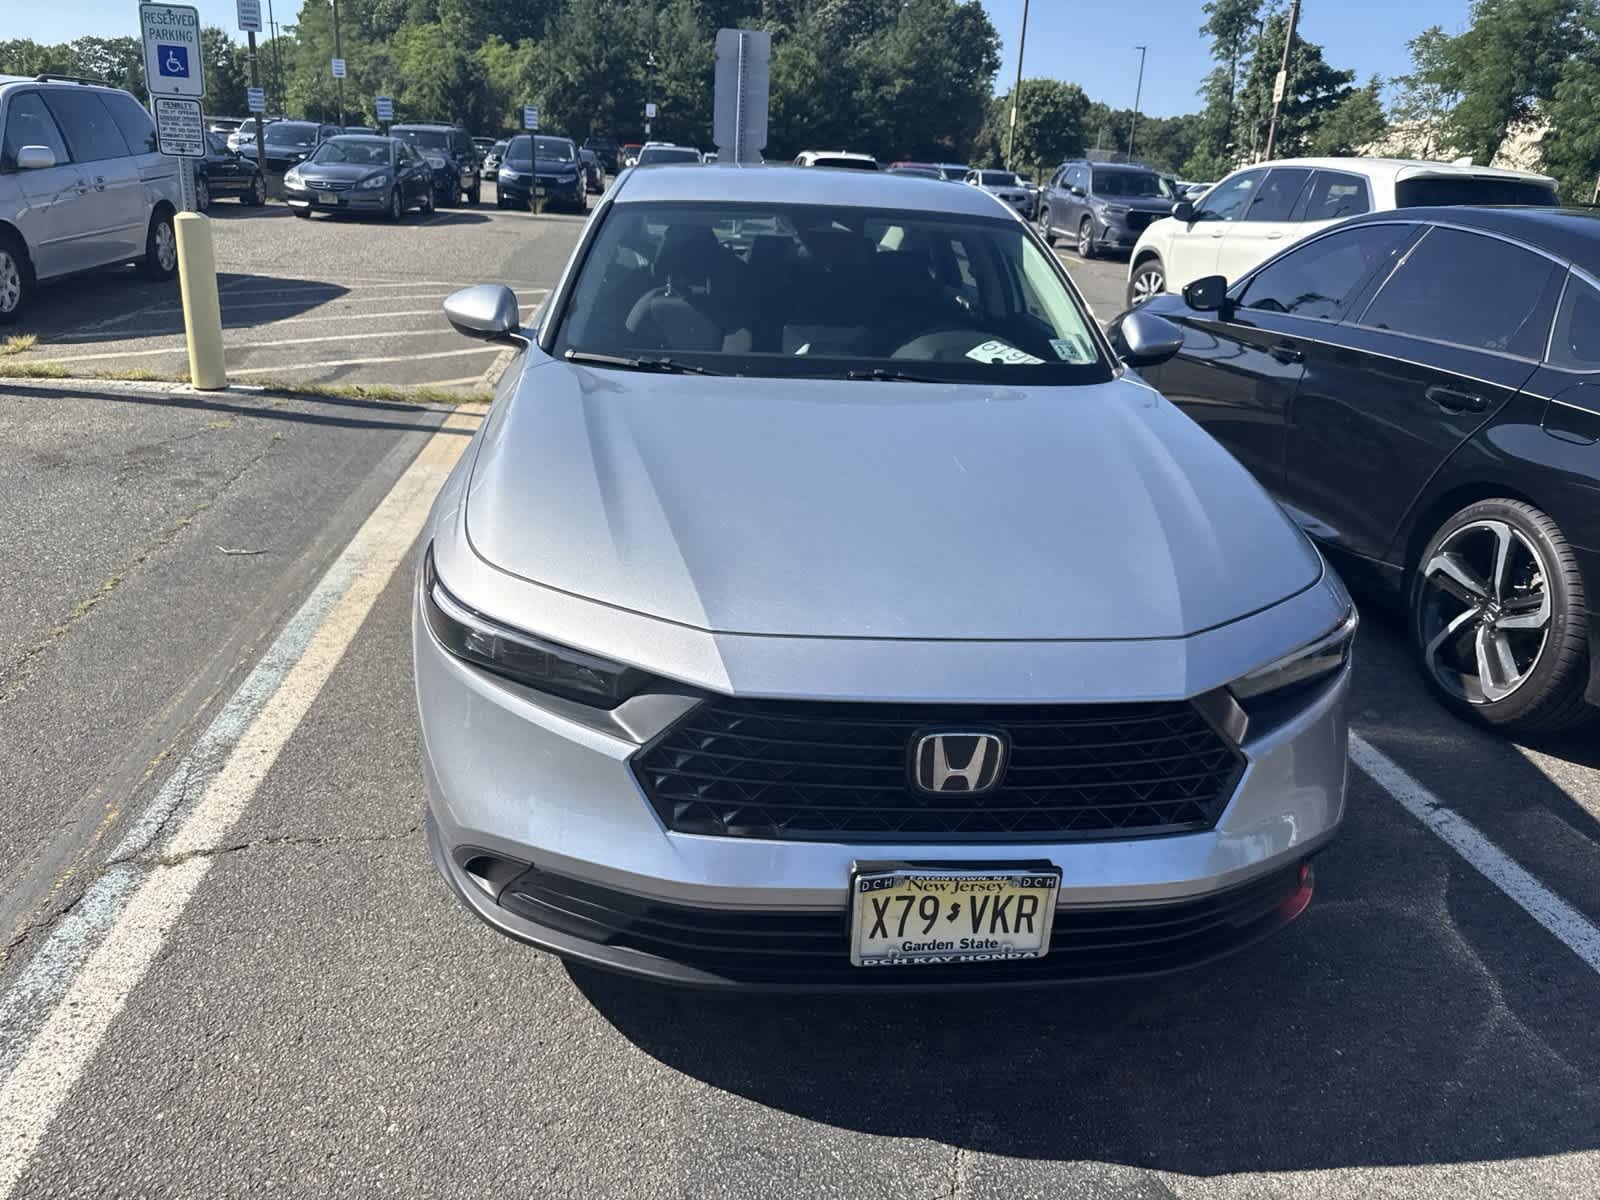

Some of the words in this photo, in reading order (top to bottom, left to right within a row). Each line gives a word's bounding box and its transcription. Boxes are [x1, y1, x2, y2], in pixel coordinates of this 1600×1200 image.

[144, 11, 195, 26] RESERVED
[149, 27, 193, 42] PARKING
[905, 879, 949, 891] New
[950, 879, 1007, 894] Jersey
[869, 895, 940, 938] X79
[970, 895, 1039, 934] VKR
[902, 939, 954, 952] Garden
[960, 938, 998, 949] State
[863, 958, 908, 966] DCH
[914, 956, 953, 964] KAY
[960, 953, 1037, 962] HONDA
